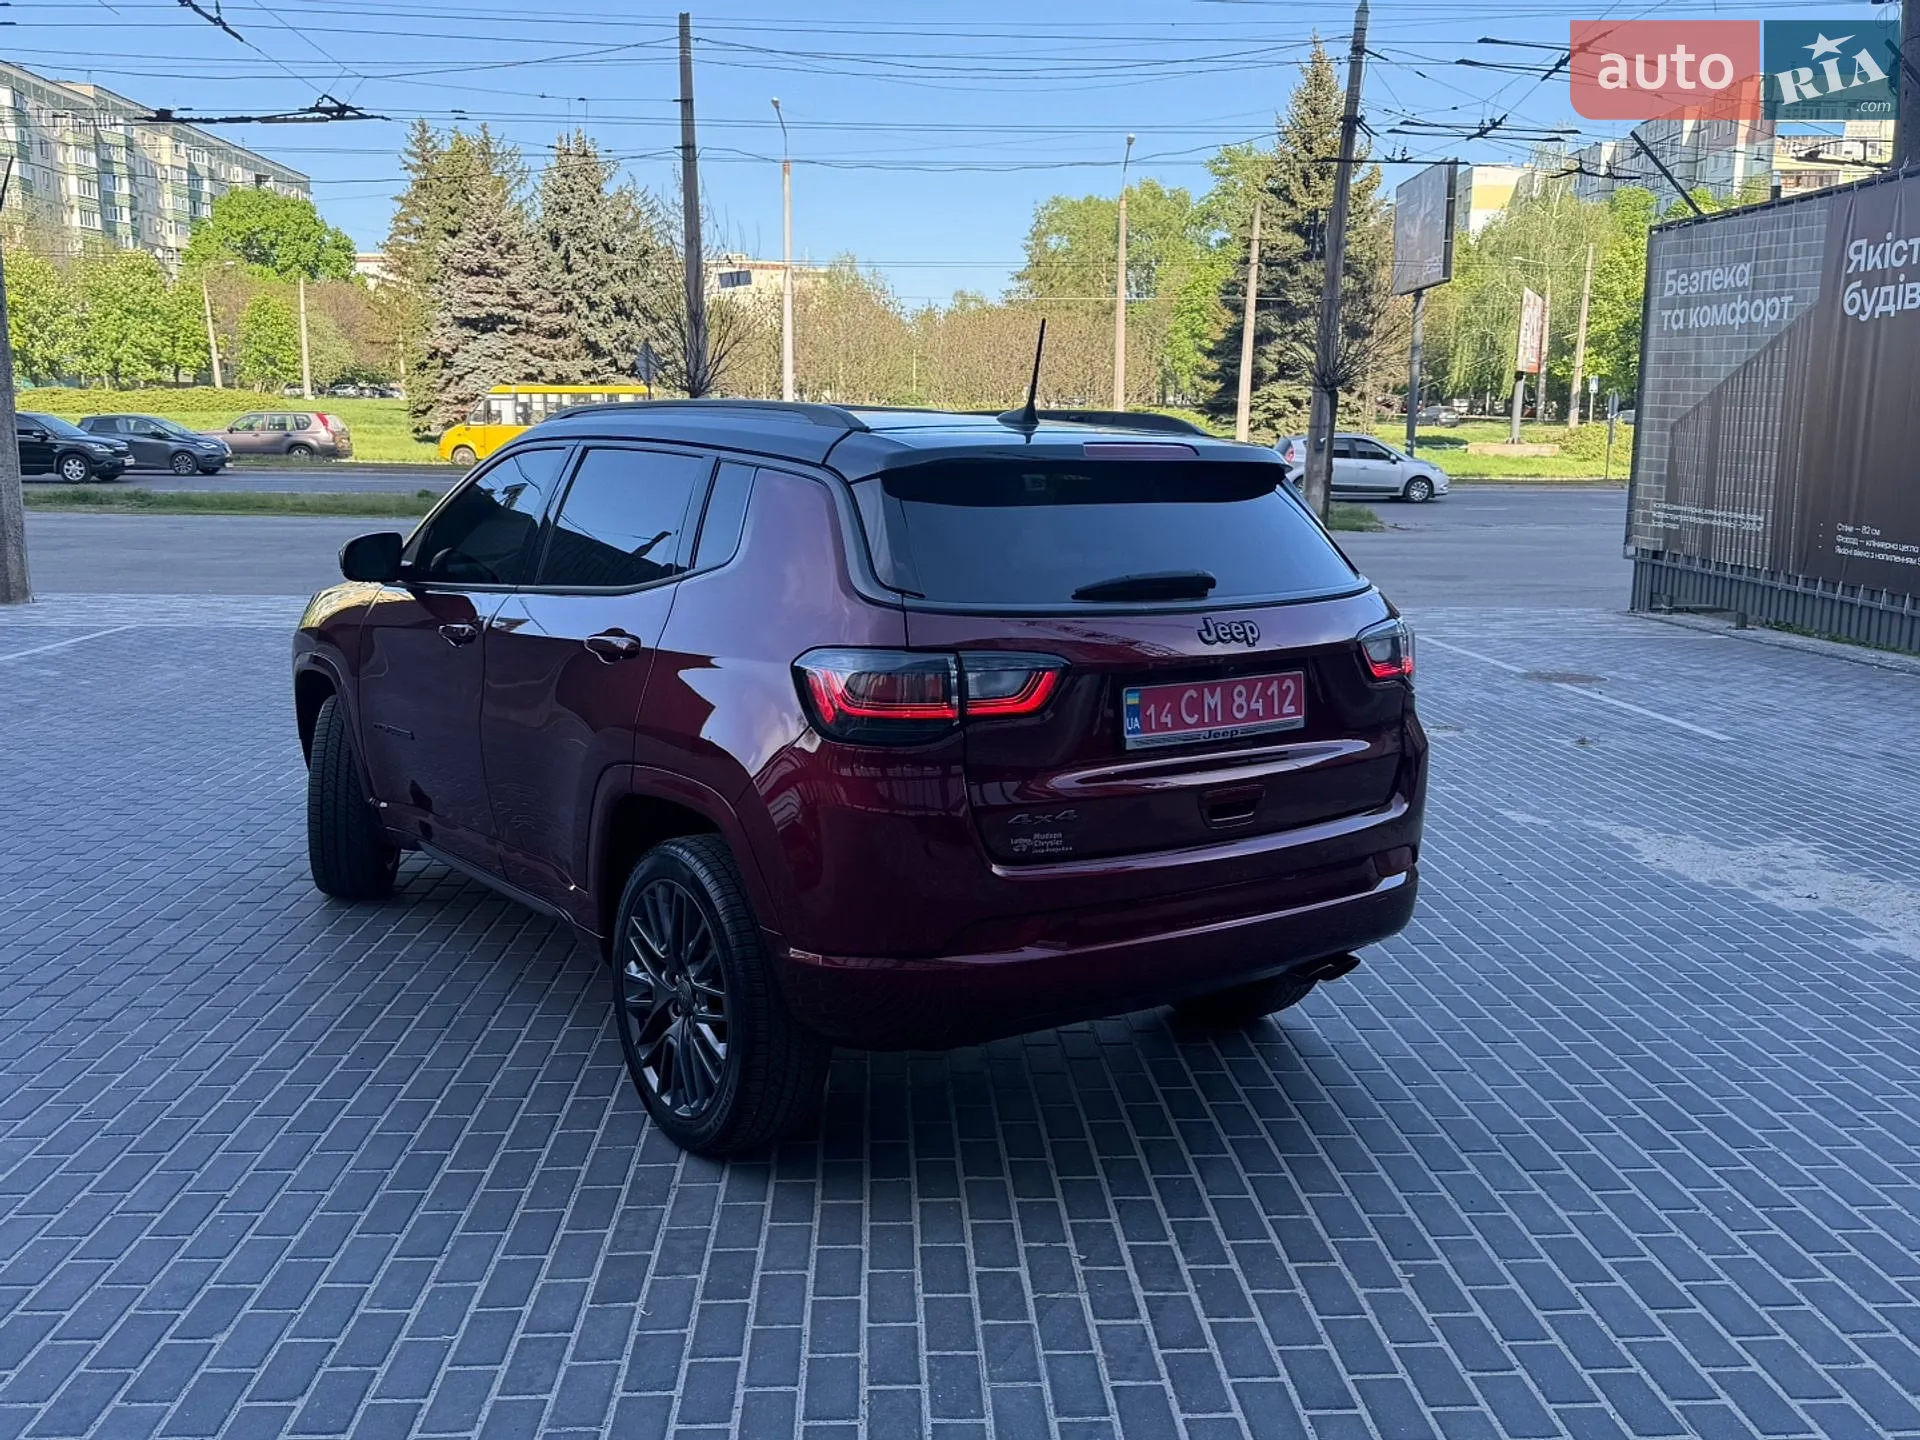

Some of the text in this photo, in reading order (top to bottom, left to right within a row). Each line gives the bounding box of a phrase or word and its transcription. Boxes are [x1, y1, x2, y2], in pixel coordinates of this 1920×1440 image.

[1663, 261, 1751, 298] Безпека
[1842, 273, 1920, 323] будів
[1661, 294, 1794, 331] та комфорт
[1197, 617, 1260, 648] Jeep
[1145, 702, 1173, 731] 14
[1232, 678, 1297, 721] 8412
[1126, 716, 1140, 731] UA
[1201, 728, 1241, 741] Jeep
